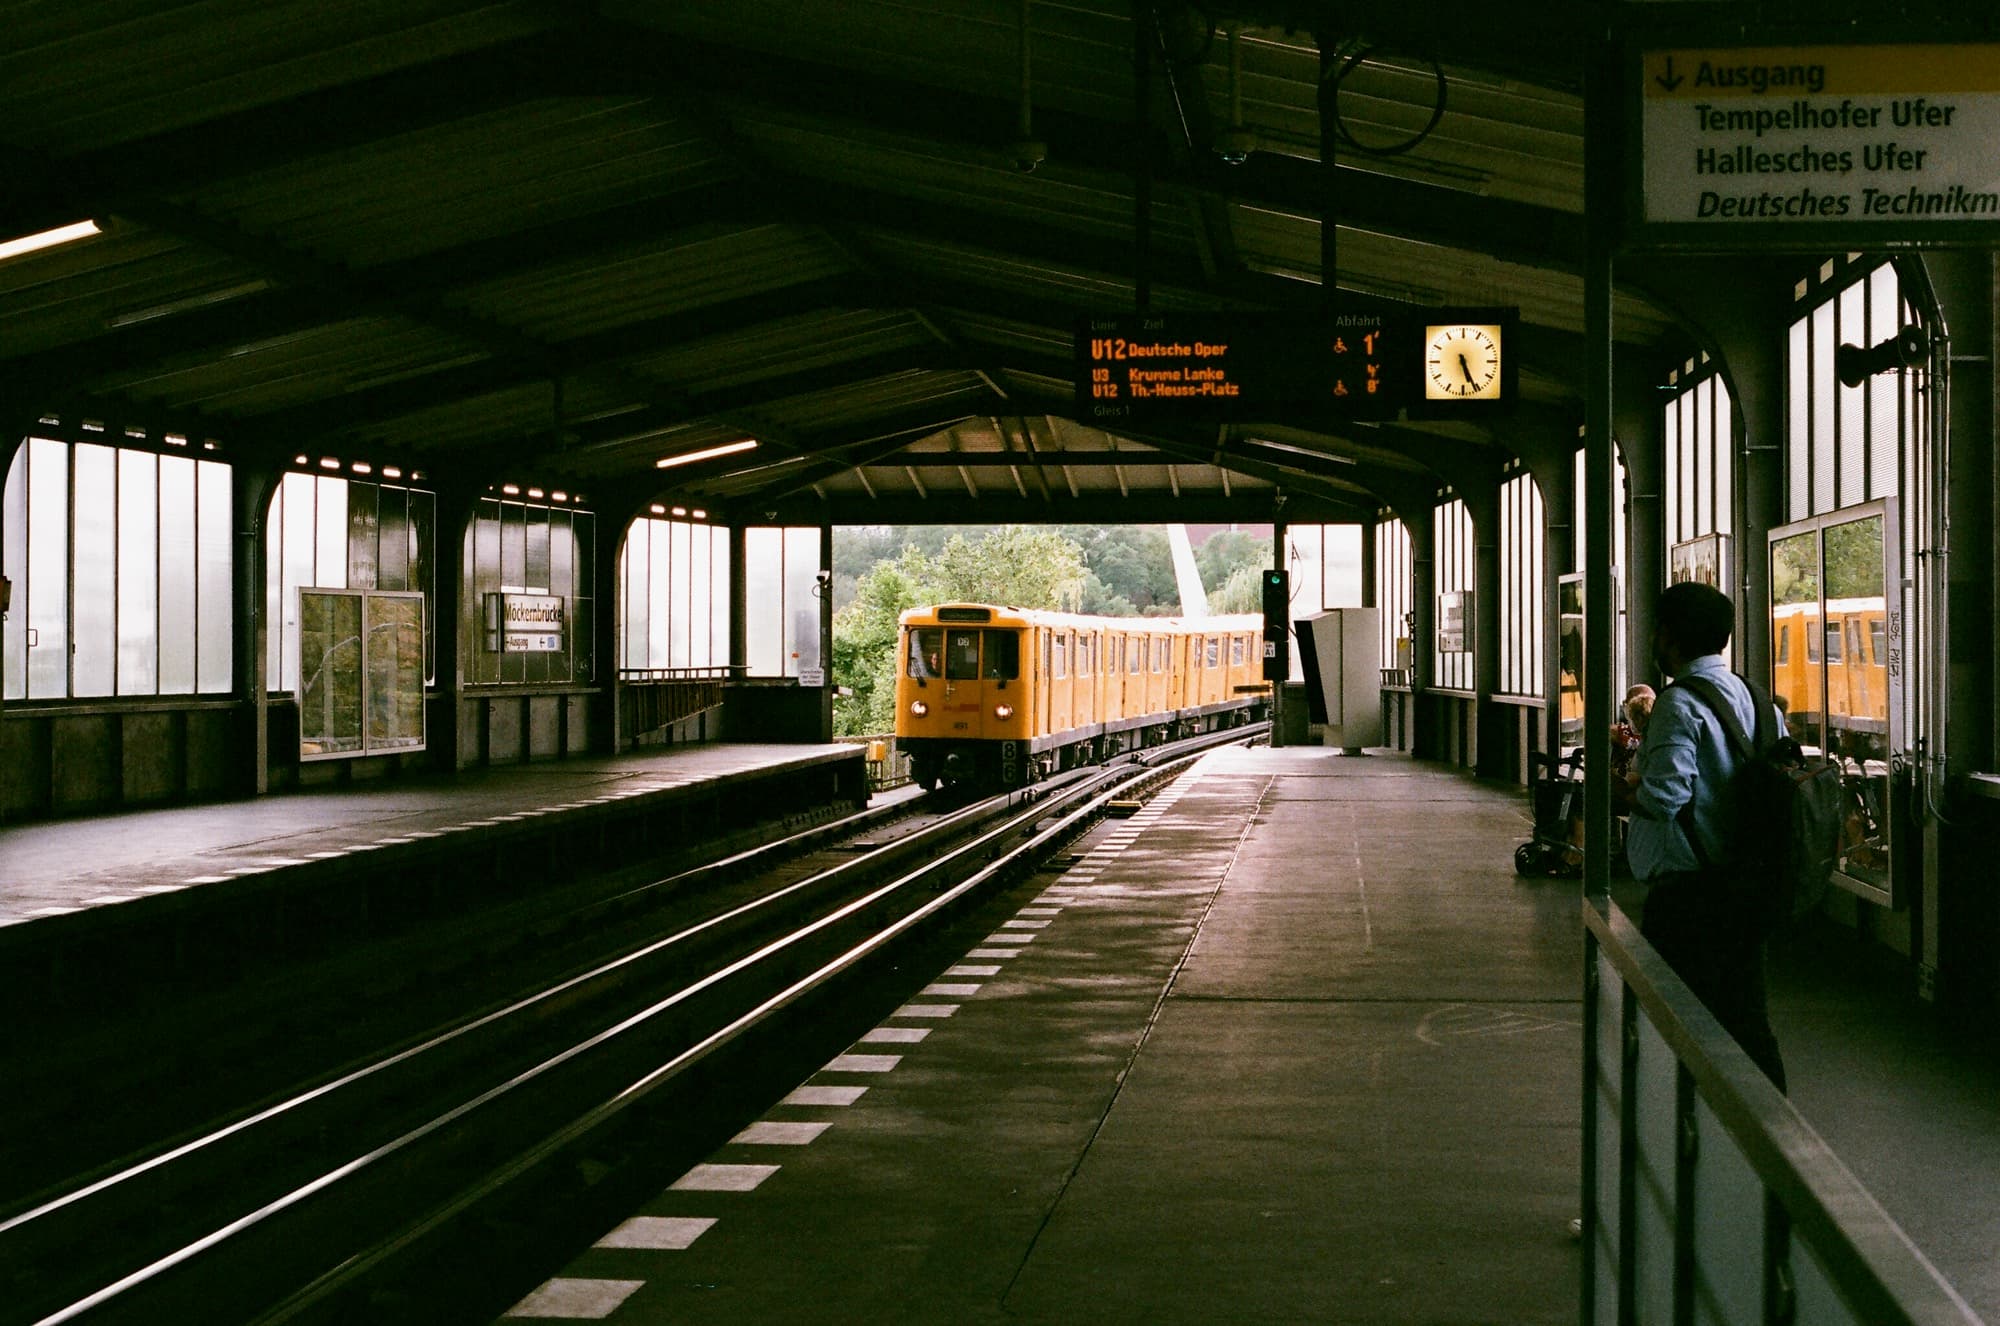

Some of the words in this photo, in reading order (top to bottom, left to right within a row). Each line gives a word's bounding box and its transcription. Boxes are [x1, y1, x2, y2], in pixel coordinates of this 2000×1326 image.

[1695, 61, 1825, 93] Ausgang
[1695, 100, 1882, 137] Tempelhofer
[1891, 98, 1956, 128] Ufer
[1696, 144, 1853, 175] Hallesches
[1863, 142, 1928, 172] Ufer
[1697, 187, 1851, 218] Deutsches
[1862, 185, 2000, 216] Technikm
[1091, 320, 1116, 331] Linie
[1143, 319, 1164, 329] Ziel
[1336, 315, 1381, 326] Abfahrt
[1091, 338, 1126, 360] U12
[1128, 343, 1191, 358] Deutsche
[1194, 342, 1228, 358] Oper
[1092, 368, 1109, 382] U3
[1128, 368, 1181, 381] Krumme
[1184, 367, 1224, 381] Lanke
[1092, 383, 1118, 398] U12
[1129, 382, 1239, 398] Th.-Heuss-Platz
[1094, 406, 1121, 416] Gleis
[504, 602, 562, 622] Möckernbrücke
[510, 636, 529, 649] Ausgang
[1004, 742, 1015, 759] 8
